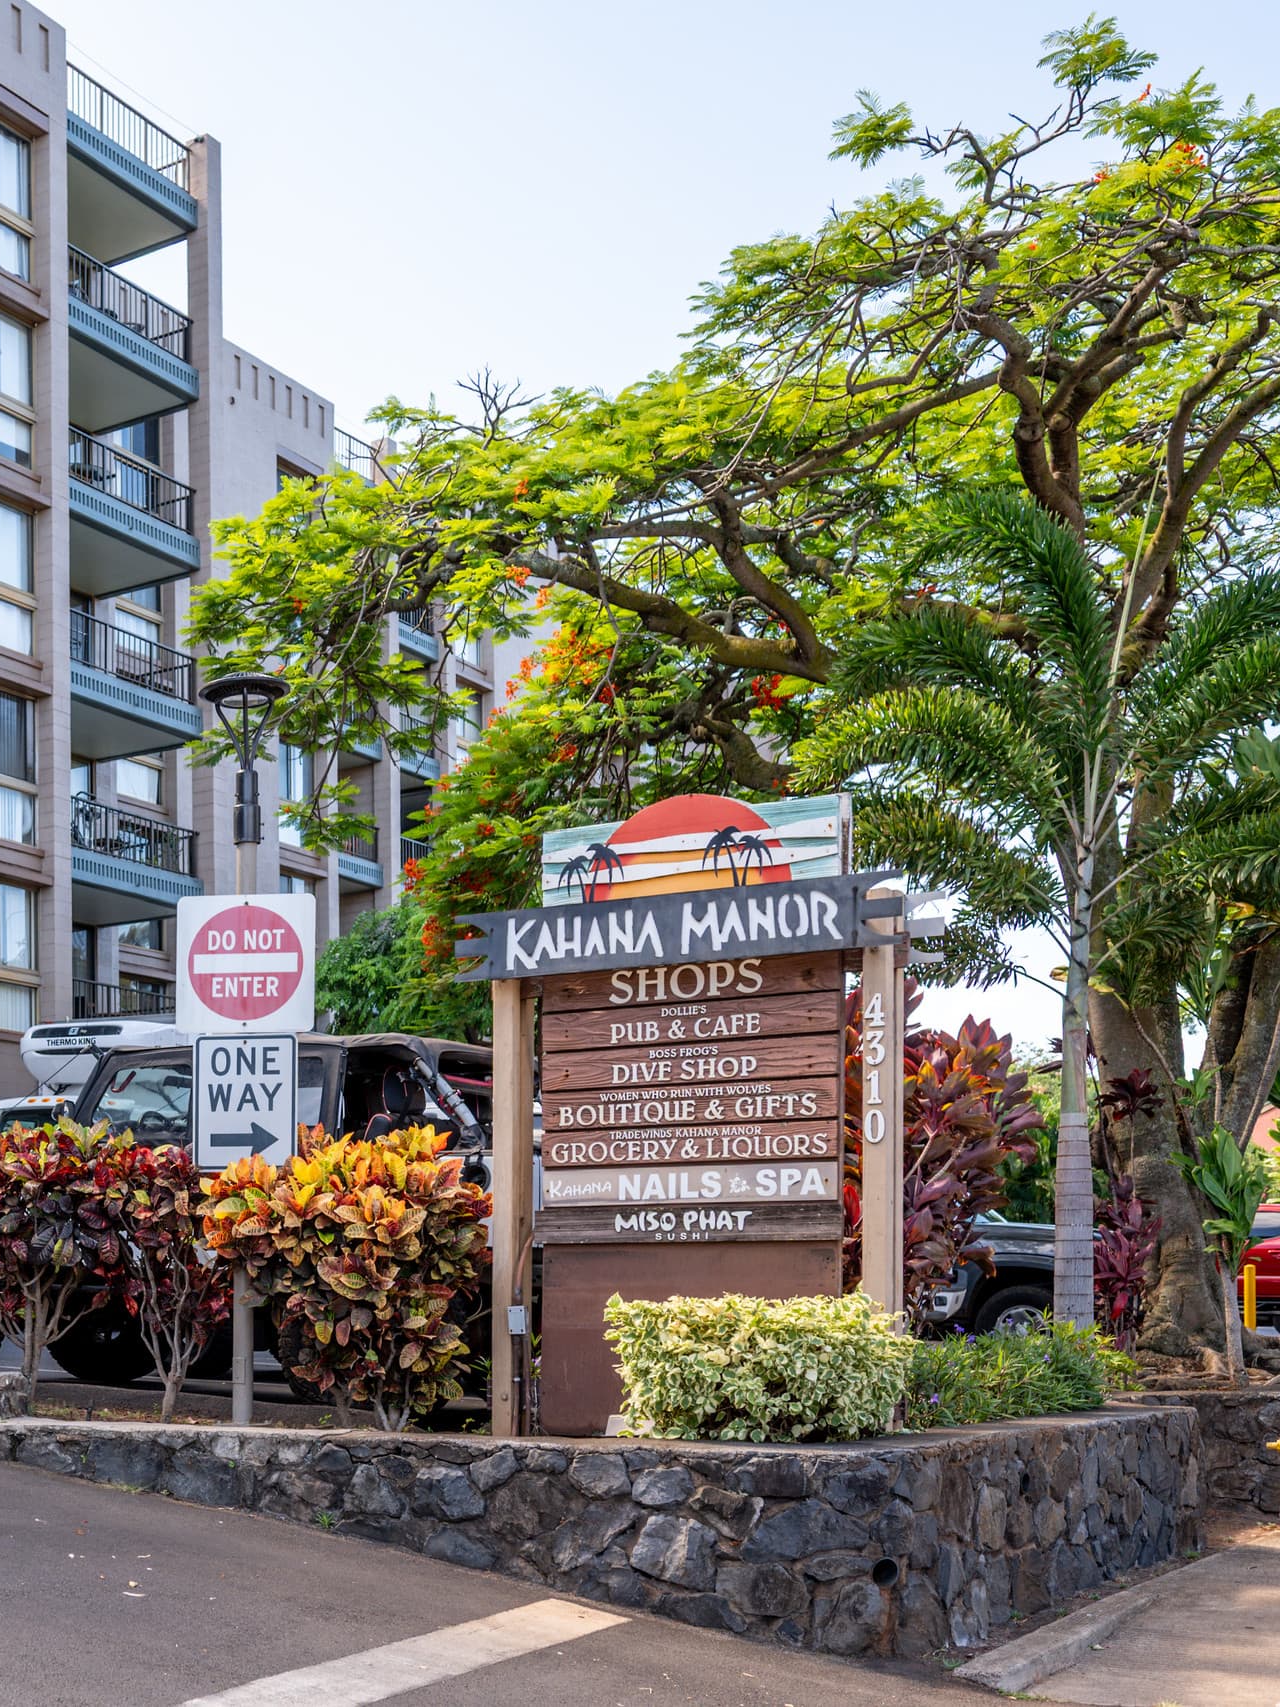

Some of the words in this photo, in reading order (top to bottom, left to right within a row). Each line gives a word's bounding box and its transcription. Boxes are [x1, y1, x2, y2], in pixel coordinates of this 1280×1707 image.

[208, 930, 236, 951] DO
[244, 929, 285, 950] NOT
[506, 910, 664, 971] KAHANA
[681, 891, 843, 955] MANOR
[212, 976, 279, 998] ENTER
[609, 958, 763, 1005] SHOPS
[661, 1004, 707, 1018] DOLLIE'S
[47, 1038, 77, 1047] THERMO
[78, 1036, 97, 1046] KING
[610, 1021, 660, 1044] PUB
[668, 1019, 686, 1040] &
[693, 1012, 761, 1038] CAFE
[211, 1046, 281, 1077] ONE
[649, 1048, 677, 1060] BOSS
[679, 1045, 718, 1058] FROG'S
[611, 1061, 672, 1085] DIVE
[680, 1055, 757, 1080] SHOP
[864, 992, 886, 1144] 4310
[208, 1083, 282, 1112] WAY
[599, 1090, 639, 1102] WOMEN
[642, 1088, 669, 1101] WHO
[671, 1087, 693, 1099] RUN
[694, 1085, 724, 1098] WITH
[726, 1083, 771, 1096] WOLVES
[558, 1100, 696, 1127] BOUTIQUE
[704, 1099, 725, 1120] &
[735, 1093, 817, 1118] GIFTS
[610, 1129, 672, 1140] TRADEWINDS
[675, 1126, 720, 1138] KAHANA
[722, 1125, 762, 1136] MANOR
[551, 1137, 678, 1164] GROCERY
[680, 1138, 700, 1159] &
[706, 1132, 828, 1160] LIQUORS
[549, 1180, 612, 1199] KAHANA
[619, 1171, 722, 1201] NAILS
[755, 1168, 827, 1197] SPA
[614, 1211, 676, 1233] MISO
[683, 1210, 753, 1232] PHAT
[655, 1231, 709, 1241] SUSHI
